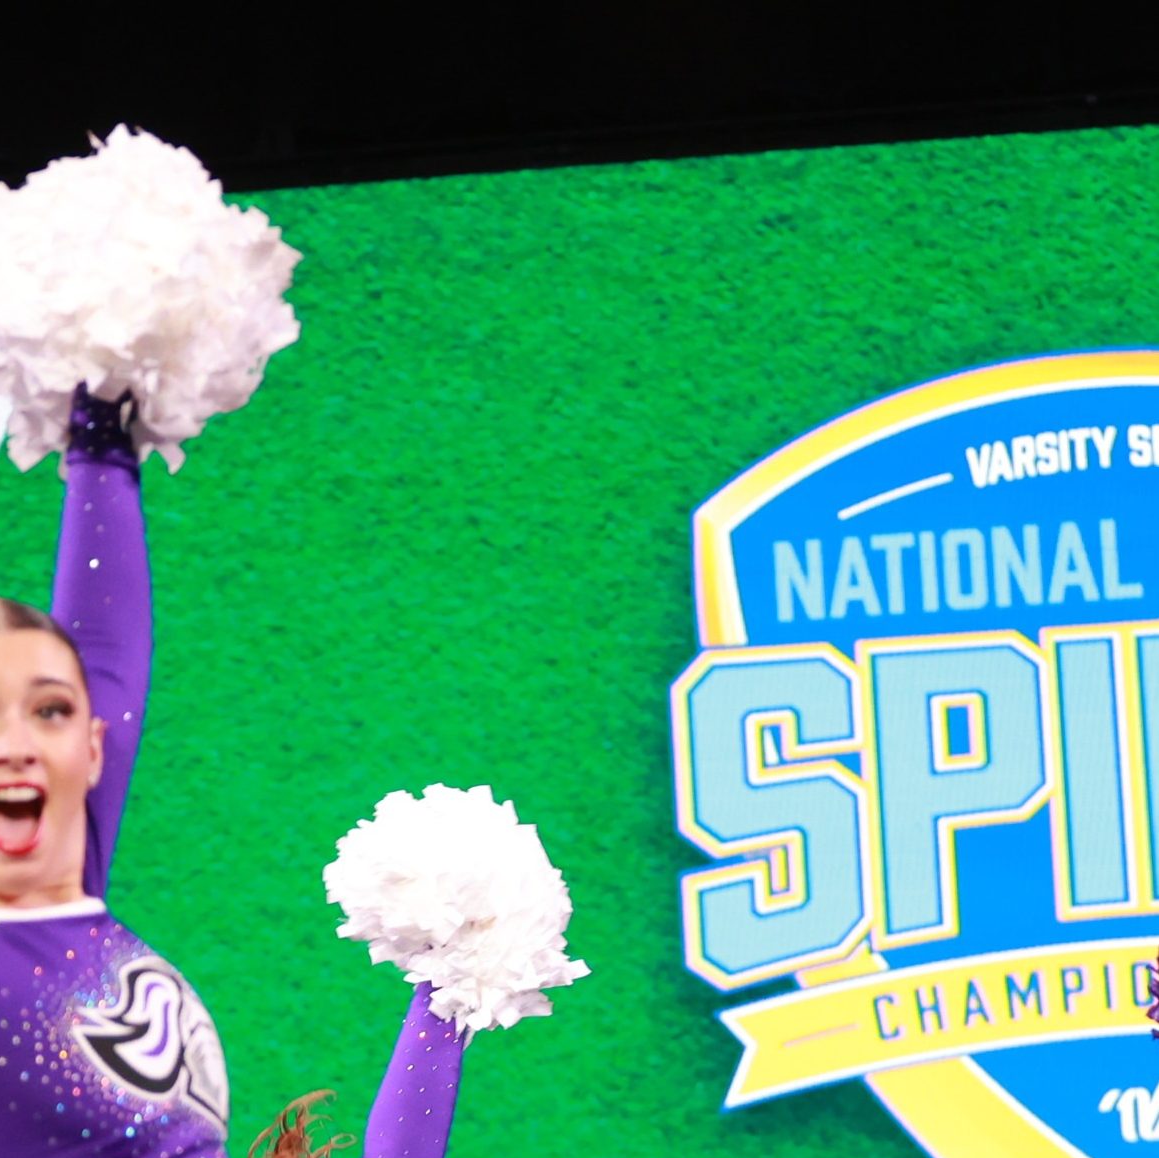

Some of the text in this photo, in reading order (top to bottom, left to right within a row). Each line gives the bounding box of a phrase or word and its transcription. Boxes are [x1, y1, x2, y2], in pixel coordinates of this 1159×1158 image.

[965, 424, 1117, 489] VARSITY
[773, 518, 1144, 623] NATIONAL
[670, 625, 1159, 989] SPI
